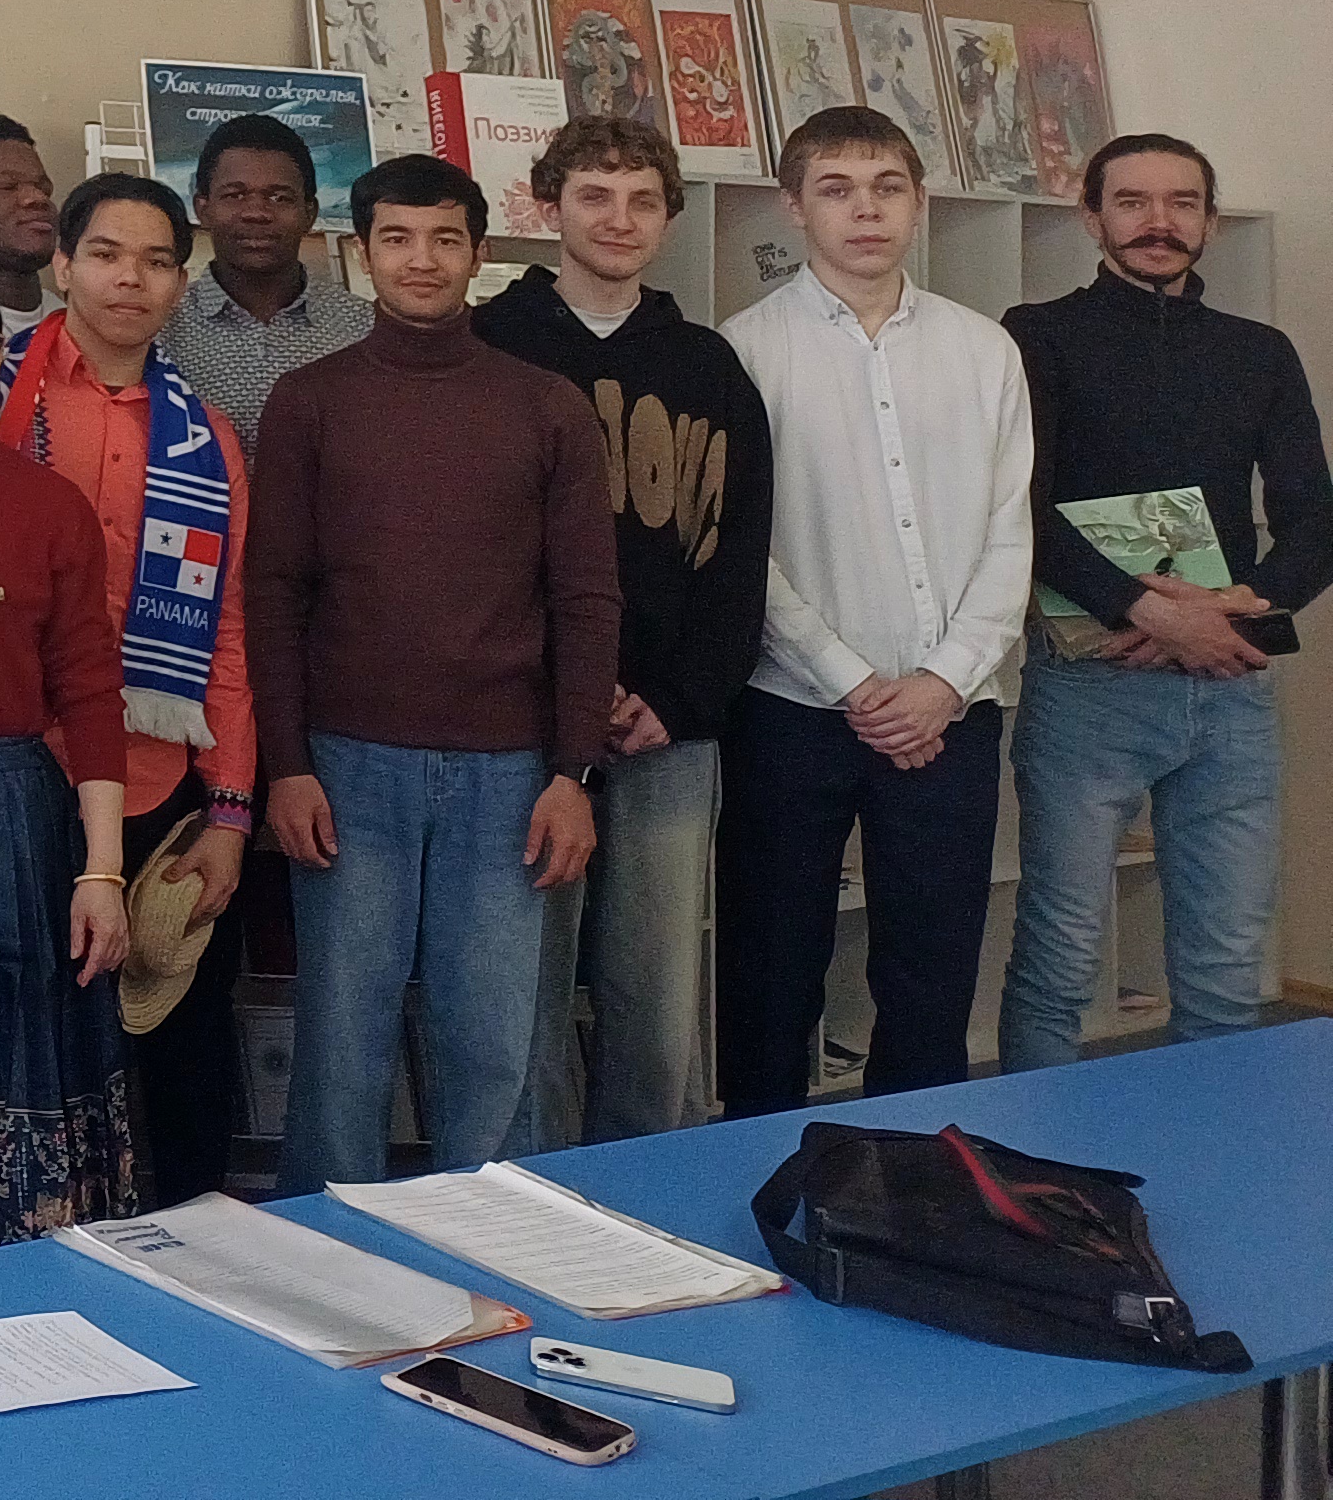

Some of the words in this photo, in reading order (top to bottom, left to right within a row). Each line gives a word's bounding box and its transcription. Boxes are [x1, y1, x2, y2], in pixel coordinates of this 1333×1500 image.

[154, 70, 202, 95] Как
[204, 82, 262, 99] нитки
[265, 79, 361, 106] ожерелья,
[186, 106, 247, 126] стро
[135, 595, 209, 631] PANAMA
